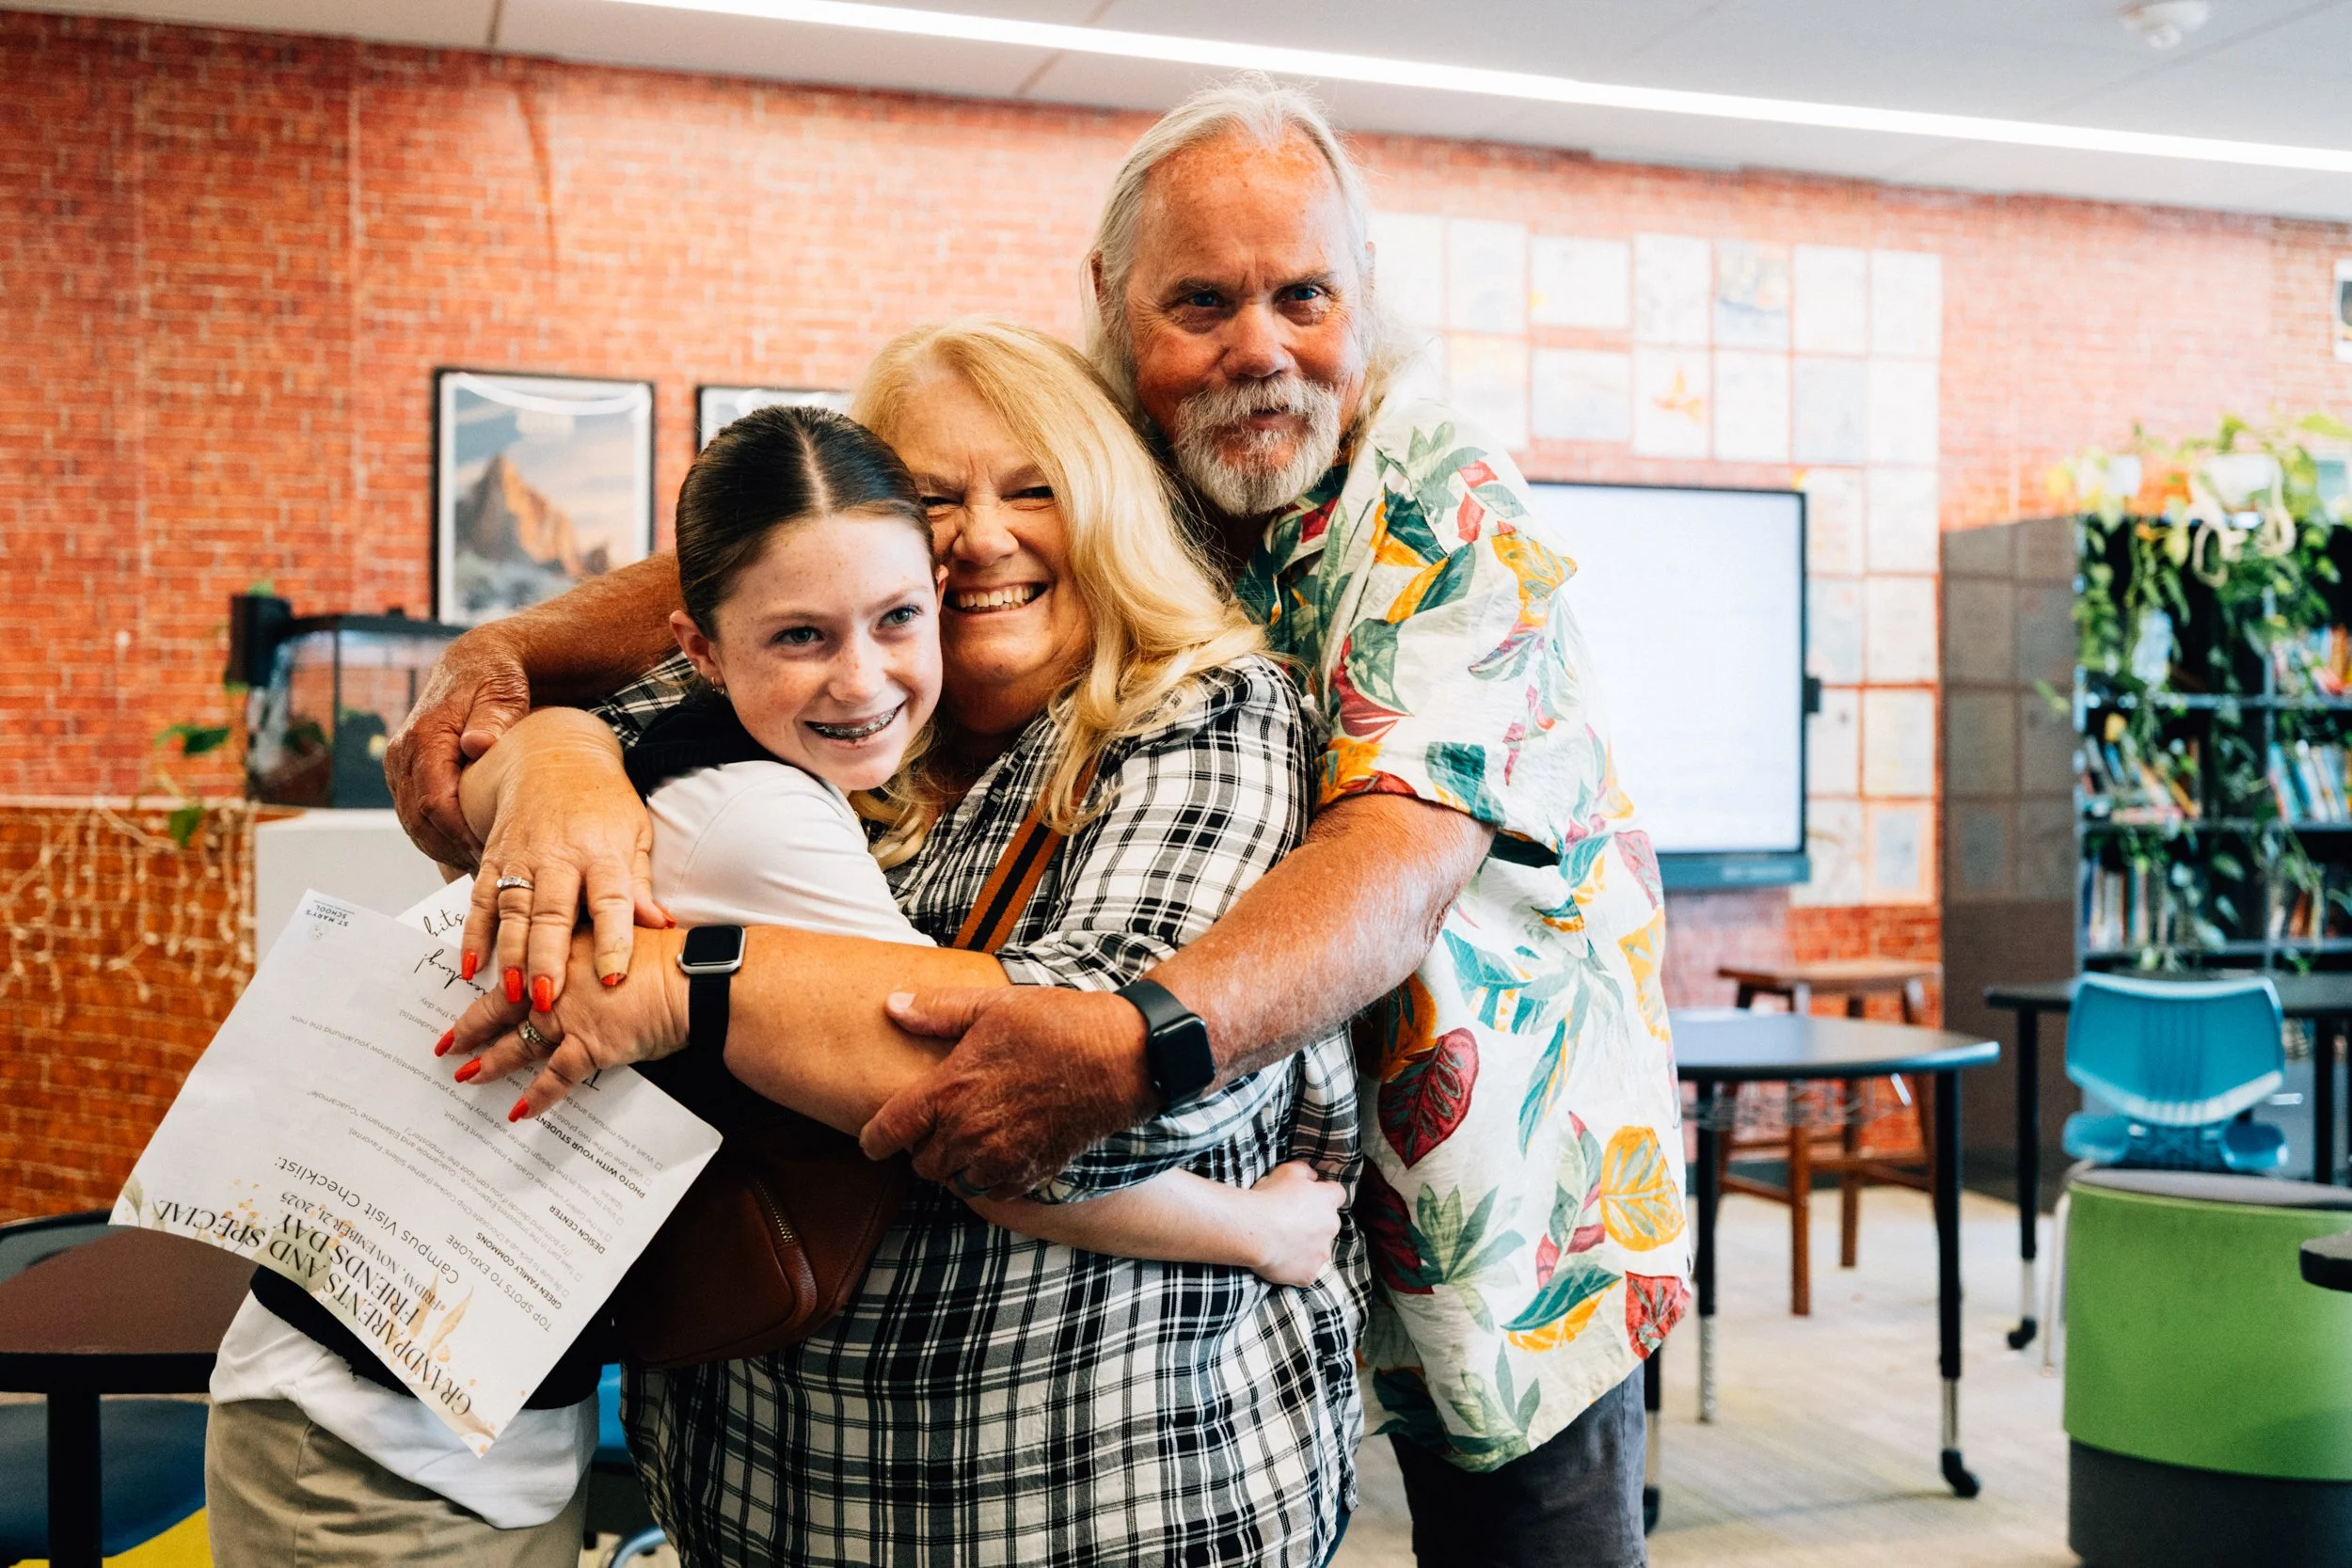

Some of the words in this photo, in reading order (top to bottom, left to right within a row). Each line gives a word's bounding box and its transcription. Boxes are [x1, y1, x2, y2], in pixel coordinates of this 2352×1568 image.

[306, 910, 336, 924] MARY'S
[316, 905, 347, 919] SCHOOL
[290, 1014, 309, 1024] new
[434, 1005, 450, 1019] the
[307, 1020, 324, 1031] the
[324, 1026, 353, 1041] around
[353, 1038, 371, 1049] you
[370, 1046, 392, 1059] show
[392, 1055, 432, 1082] student(s)
[431, 1078, 451, 1093] your
[506, 1076, 523, 1090] take
[449, 1089, 474, 1112] having
[573, 1101, 588, 1115] and
[474, 1107, 494, 1124] enjoy
[555, 1112, 580, 1133] photo
[360, 1113, 401, 1139] Edamame
[492, 1120, 508, 1134] and
[587, 1113, 616, 1136] minutes
[400, 1135, 416, 1148] and
[469, 1128, 507, 1160] Instrument
[507, 1133, 531, 1153] Center
[577, 1129, 593, 1144] two
[616, 1134, 630, 1148] few
[571, 1141, 594, 1161] YOUR
[591, 1139, 605, 1153] the
[603, 1148, 613, 1159] of
[416, 1146, 456, 1177] Guacamole
[446, 1155, 460, 1167] the
[531, 1150, 556, 1172] Design
[612, 1155, 628, 1169] one
[637, 1148, 654, 1164] Wait
[459, 1164, 476, 1179] spot
[513, 1163, 534, 1180] Grade
[556, 1168, 568, 1180] the
[596, 1159, 617, 1178] WITH
[627, 1164, 644, 1181] Visit
[275, 1157, 360, 1208] Checklist:
[475, 1176, 490, 1189] can
[533, 1176, 548, 1190] the
[567, 1177, 577, 1187] in
[618, 1175, 645, 1198] PHOTO
[433, 1181, 456, 1202] Cookie
[460, 1178, 498, 1210] Experience
[490, 1187, 504, 1199] you
[278, 1191, 315, 1214] 2025
[456, 1199, 472, 1215] Chip
[508, 1201, 531, 1221] decide
[159, 1201, 265, 1247] SPECIAL
[318, 1207, 333, 1225] 21,
[364, 1203, 397, 1236] Visit
[549, 1205, 579, 1231] CENTER
[585, 1217, 597, 1230] the
[273, 1213, 330, 1253] DAY
[472, 1212, 505, 1242] Chocolate
[530, 1219, 545, 1233] and
[529, 1231, 541, 1244] the
[544, 1231, 560, 1246] both
[578, 1228, 606, 1255] DESIGN
[332, 1219, 399, 1276] NOVEMBER
[446, 1234, 490, 1275] EXPLORE
[476, 1232, 515, 1267] COMMONS
[269, 1240, 326, 1278] AND
[401, 1230, 459, 1284] Campus
[330, 1244, 420, 1326] FRIENDS
[490, 1272, 503, 1288] TO
[514, 1265, 540, 1290] FAMILY
[503, 1284, 534, 1313] SPOTS
[538, 1287, 562, 1309] GREEN
[532, 1312, 551, 1332] TOP
[323, 1273, 471, 1415] GRANDPARENTS
